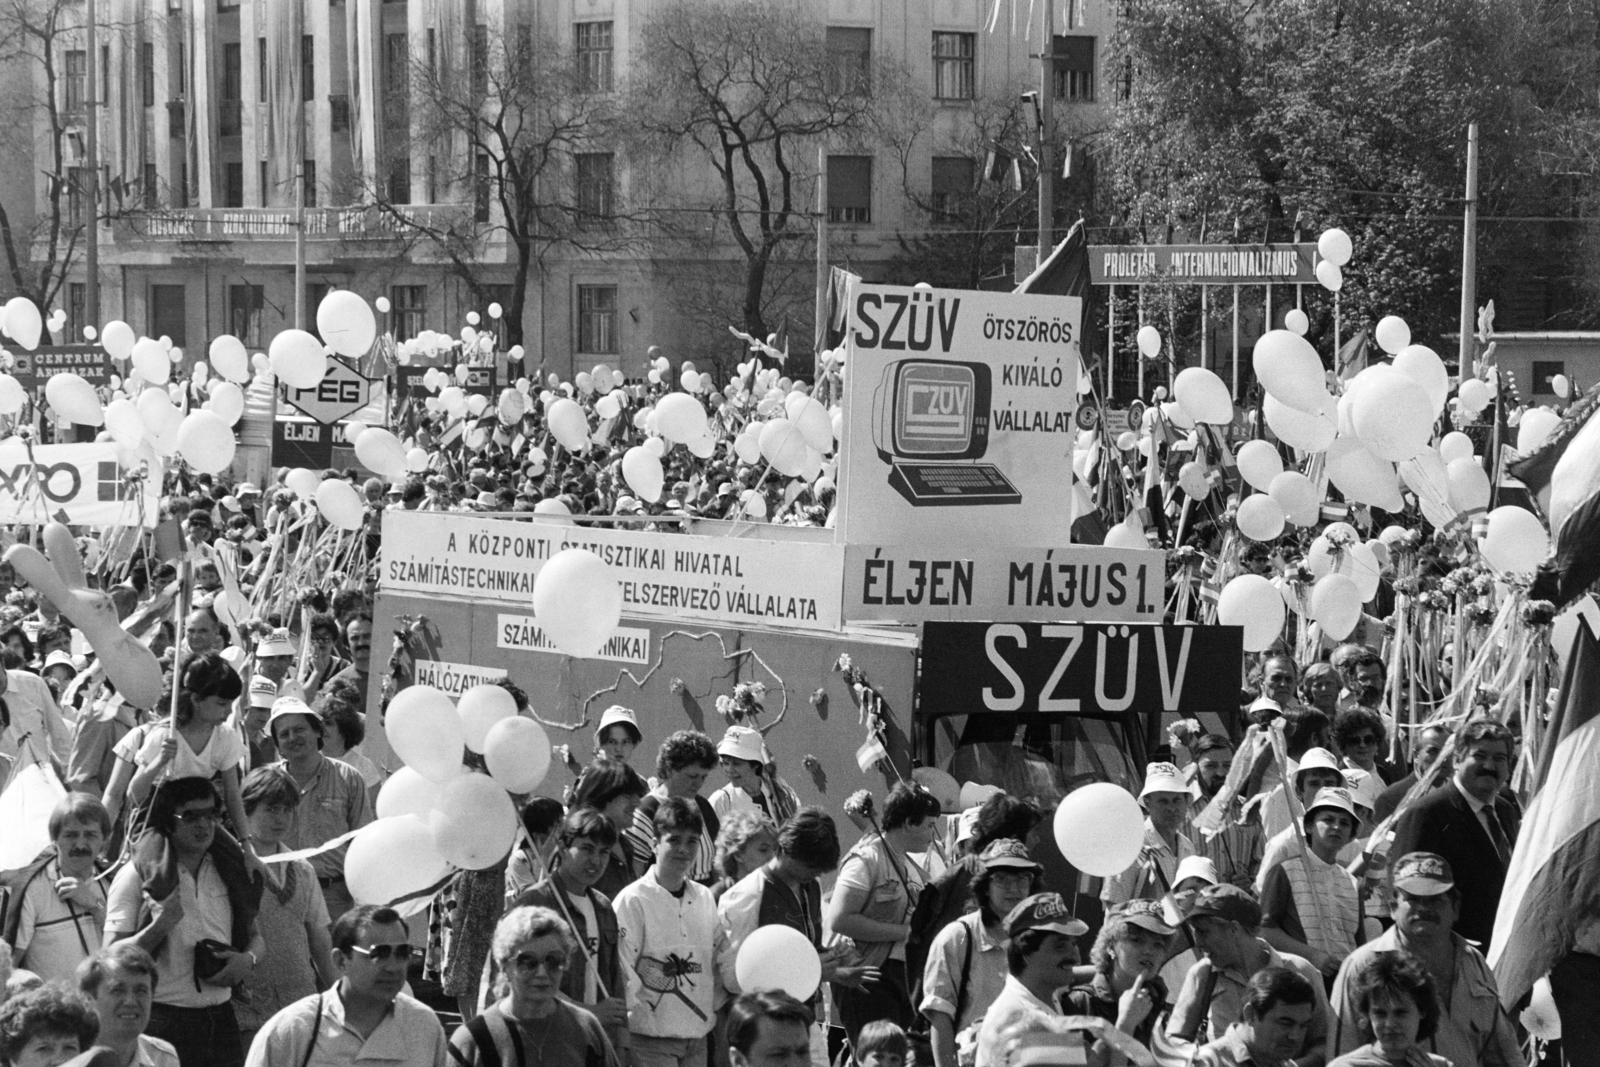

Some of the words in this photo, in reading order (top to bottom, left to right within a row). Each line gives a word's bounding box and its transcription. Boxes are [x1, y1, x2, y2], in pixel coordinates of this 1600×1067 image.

[1104, 248, 1156, 277] PROLETÁR
[1171, 250, 1298, 277] INTERNACIONALIZMUS
[855, 291, 961, 352] SZÜV
[983, 312, 1073, 344] ÖTSZÖRÖS
[35, 353, 104, 365] CENTRUM
[1002, 356, 1063, 388] KIVÁLÓ
[284, 421, 321, 442] ÉLJEN
[993, 400, 1072, 433] VÁLLALAT
[446, 532, 457, 552] A
[469, 530, 551, 560] KÖZPONTI
[674, 550, 743, 578] HIVATAL
[389, 555, 535, 594] SZÁMÍTÁSTECHNIKAI
[726, 584, 818, 621] VÁLLALATA
[863, 548, 974, 606] ÉLJEN
[1007, 550, 1127, 608] MÁJUS
[1136, 564, 1155, 614] 1.
[982, 623, 1193, 712] SZÜV
